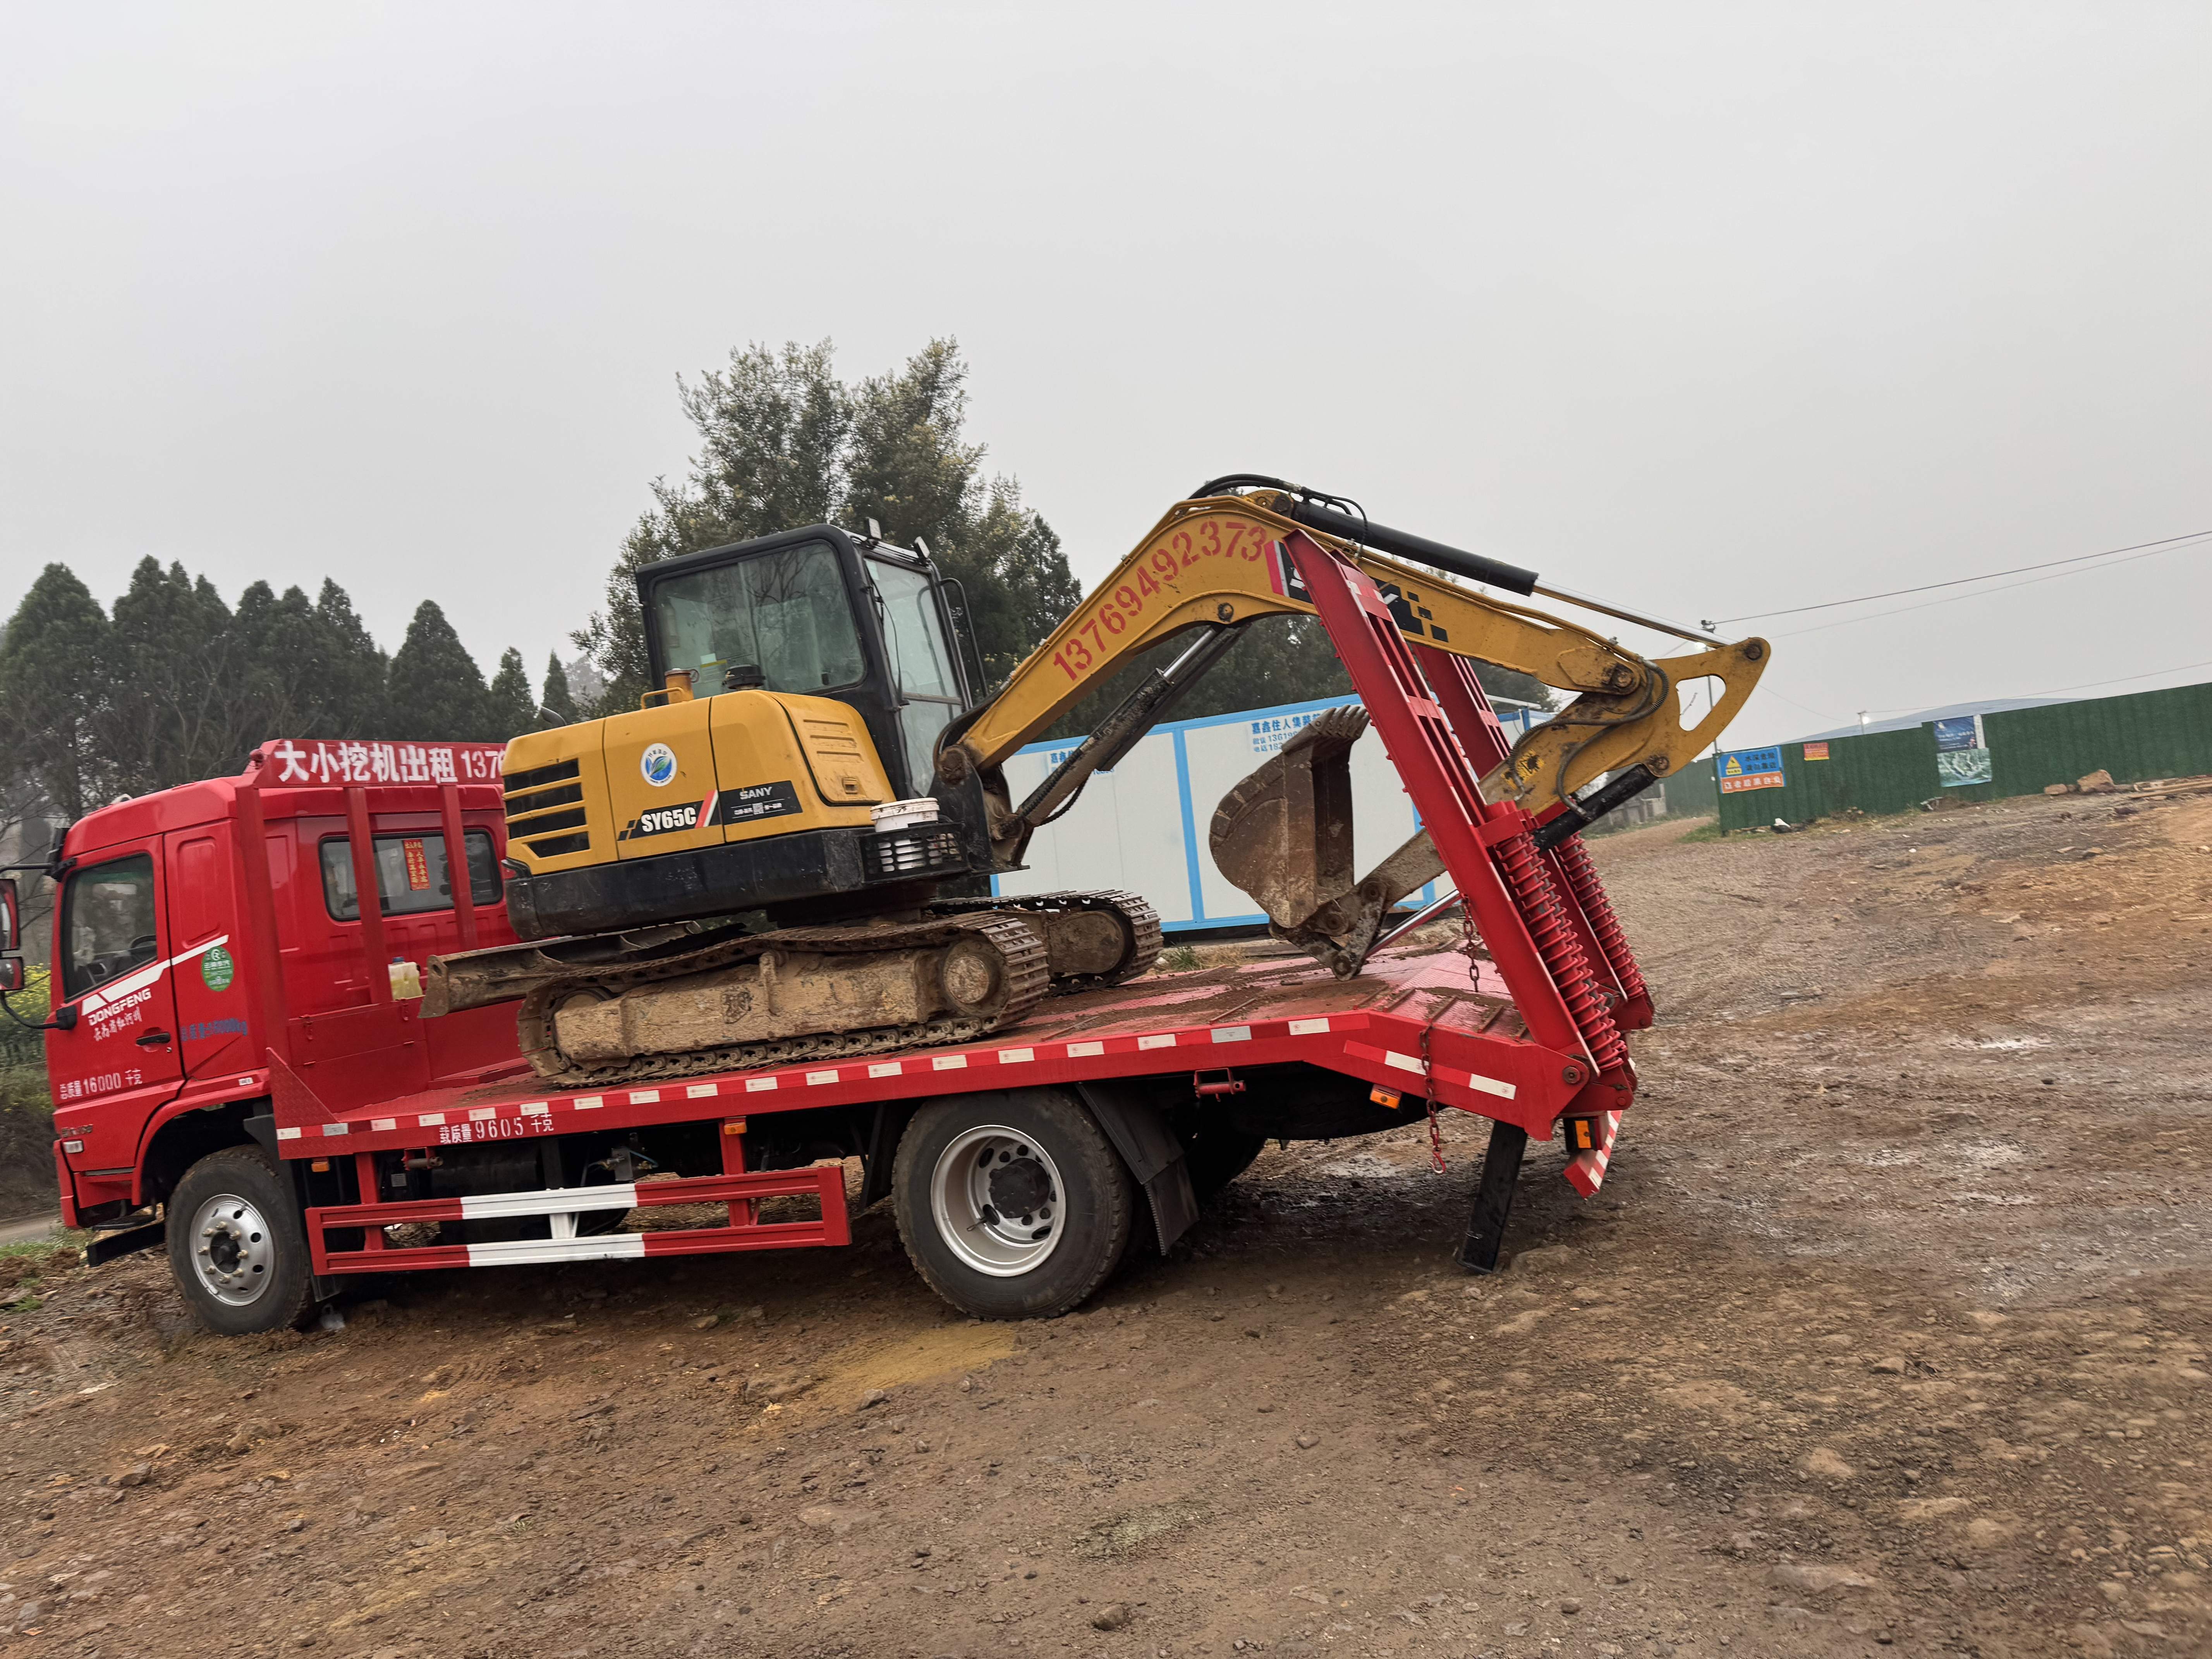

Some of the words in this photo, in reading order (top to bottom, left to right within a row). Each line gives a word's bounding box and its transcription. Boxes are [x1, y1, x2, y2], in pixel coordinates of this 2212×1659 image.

[1053, 521, 1267, 681] 13769492373
[275, 740, 457, 783] 大小挖机出租
[740, 787, 772, 800] SANY
[641, 807, 697, 832] SY65C
[88, 988, 151, 1026] DONGFENG
[83, 1073, 121, 1094] 16000
[439, 1123, 473, 1144] 载质量
[475, 1117, 523, 1139] 9605
[530, 1113, 554, 1133] 千克
